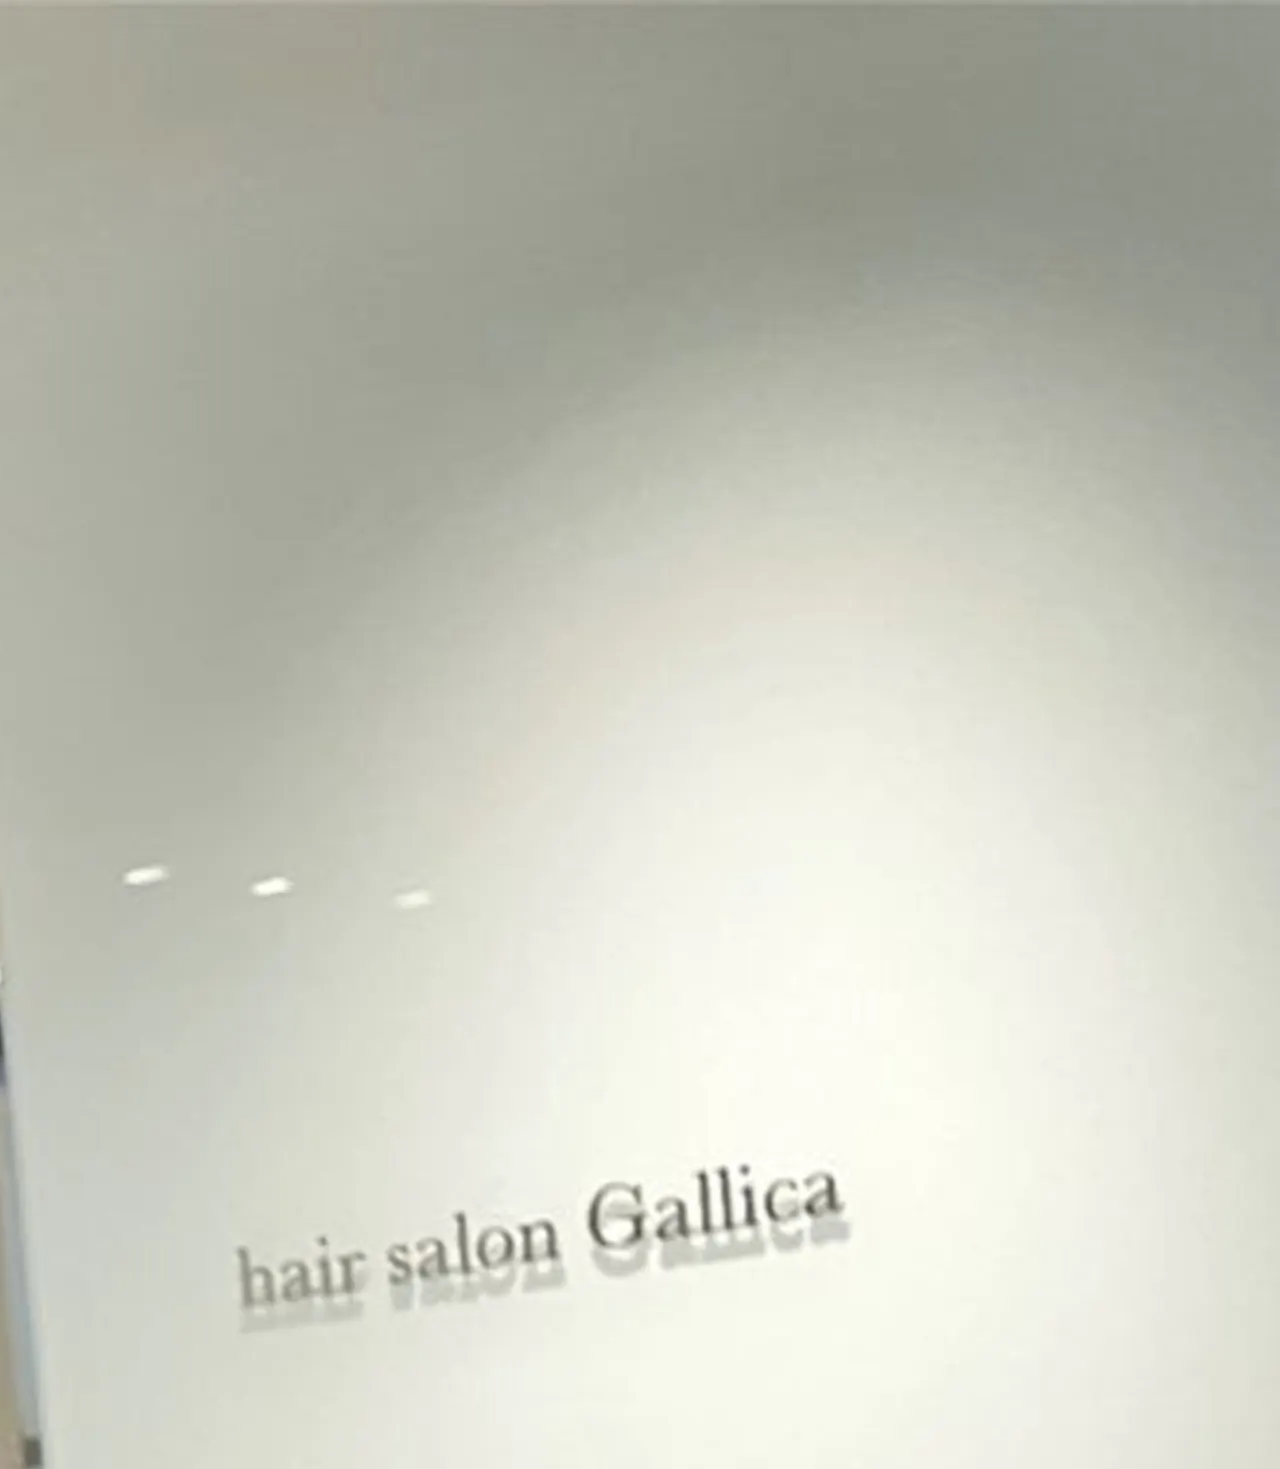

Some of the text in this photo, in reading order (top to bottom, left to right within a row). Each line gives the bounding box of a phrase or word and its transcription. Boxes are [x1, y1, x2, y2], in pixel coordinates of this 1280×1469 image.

[236, 1164, 845, 1306] hair salon Gallica
